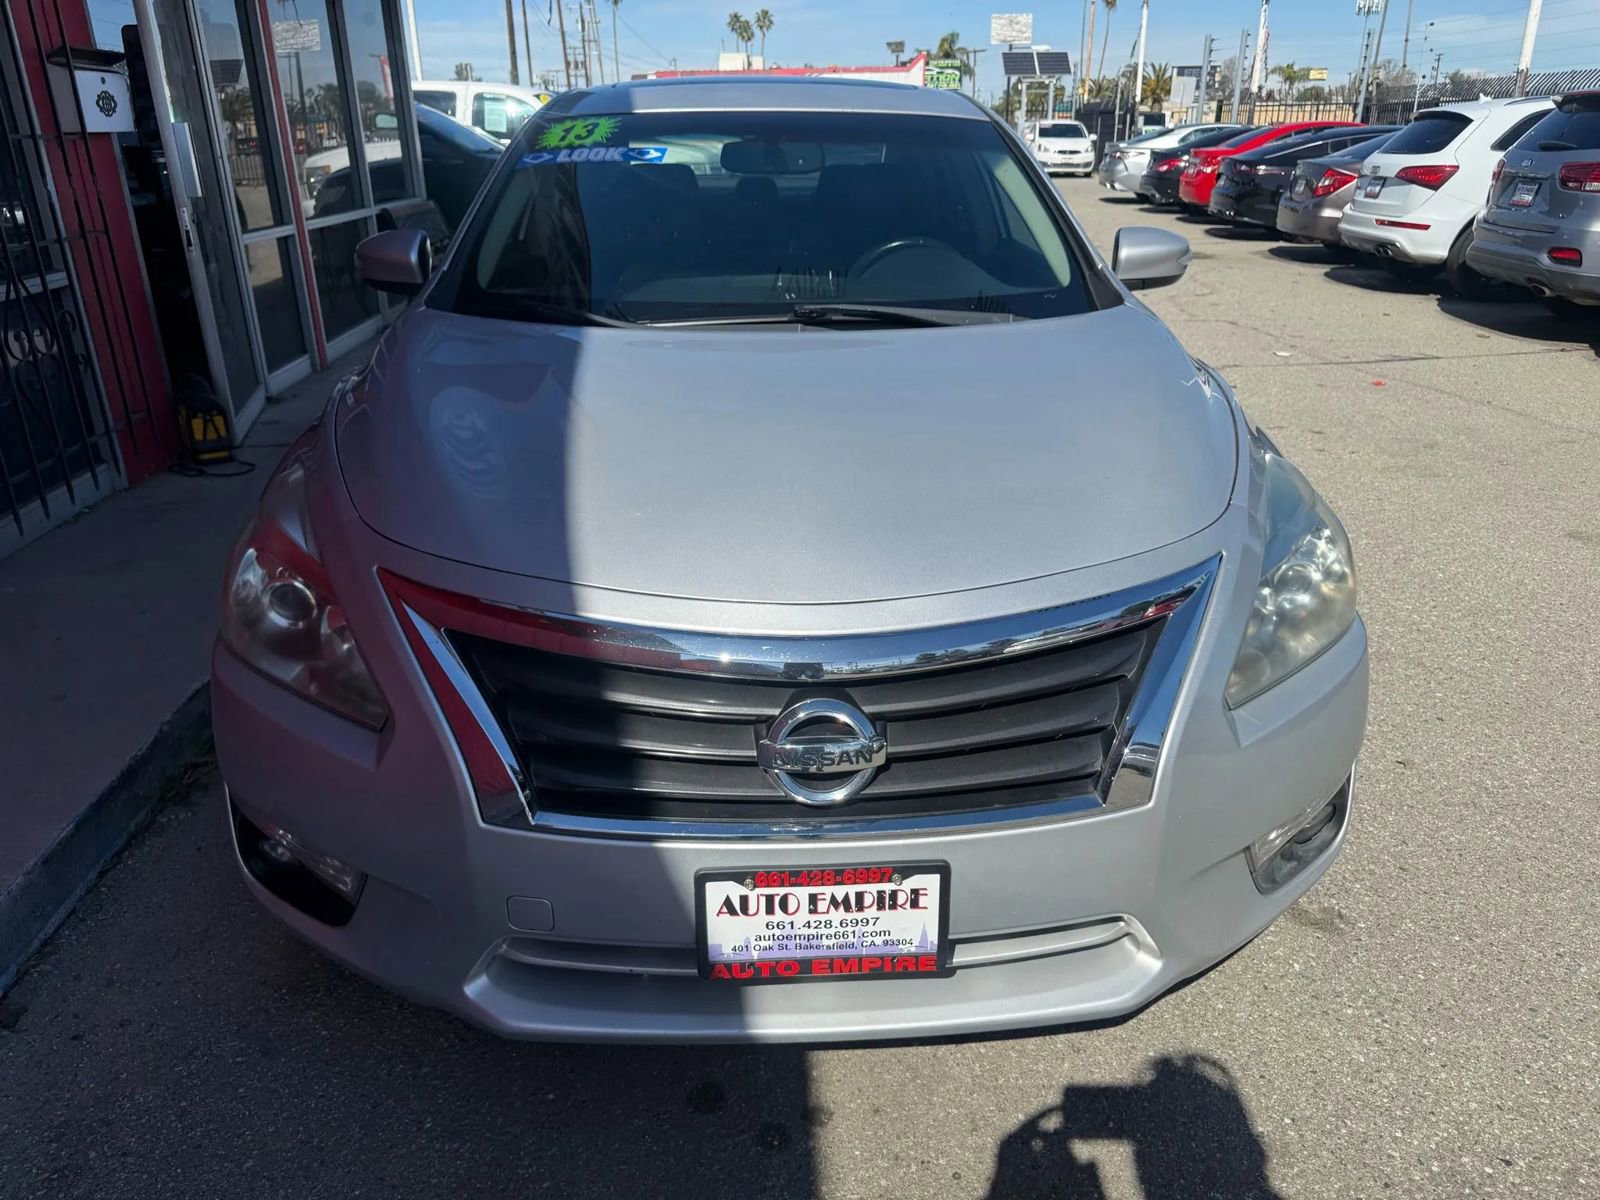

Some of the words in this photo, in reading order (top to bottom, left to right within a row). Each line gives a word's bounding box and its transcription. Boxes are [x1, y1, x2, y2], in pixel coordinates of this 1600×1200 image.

[558, 122, 600, 143] 13
[556, 147, 628, 162] LOOK
[773, 744, 873, 768] NISSAN
[755, 868, 893, 888] 661-428-6997
[716, 892, 800, 917] AUTO
[808, 888, 928, 914] EMPIRE
[765, 917, 880, 930] 661.428.6997
[731, 944, 750, 953] 401
[753, 943, 774, 952] Oak
[777, 943, 791, 951] St.
[795, 941, 858, 951] Bakersfield,
[861, 940, 879, 948] CA.
[882, 938, 914, 946] 93304
[754, 928, 891, 943] autoempire661.com
[710, 961, 800, 979] AUTO
[811, 955, 937, 975] EMPIRE
